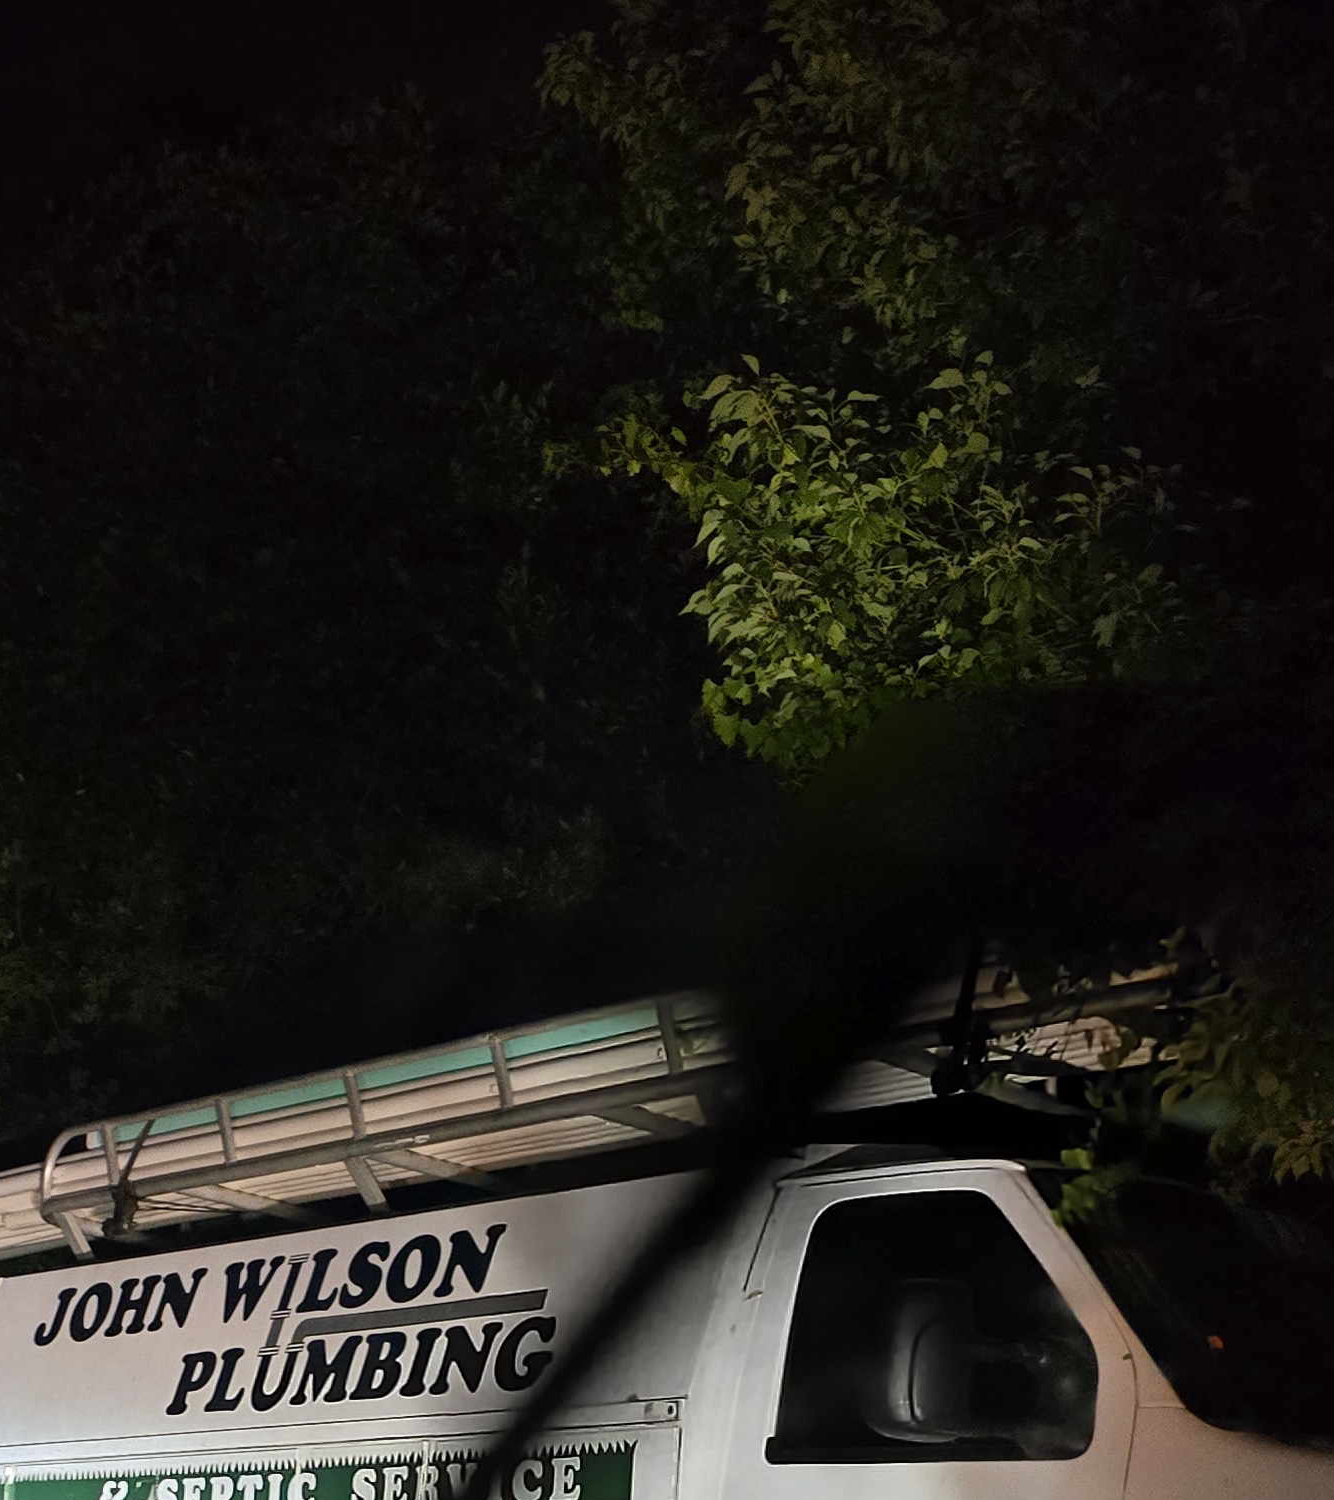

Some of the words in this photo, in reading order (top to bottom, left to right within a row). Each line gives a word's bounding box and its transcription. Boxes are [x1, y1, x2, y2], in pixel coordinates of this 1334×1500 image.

[35, 1267, 208, 1347] JOHN
[222, 1223, 508, 1324] WILSON
[165, 1316, 557, 1416] PLUMBING
